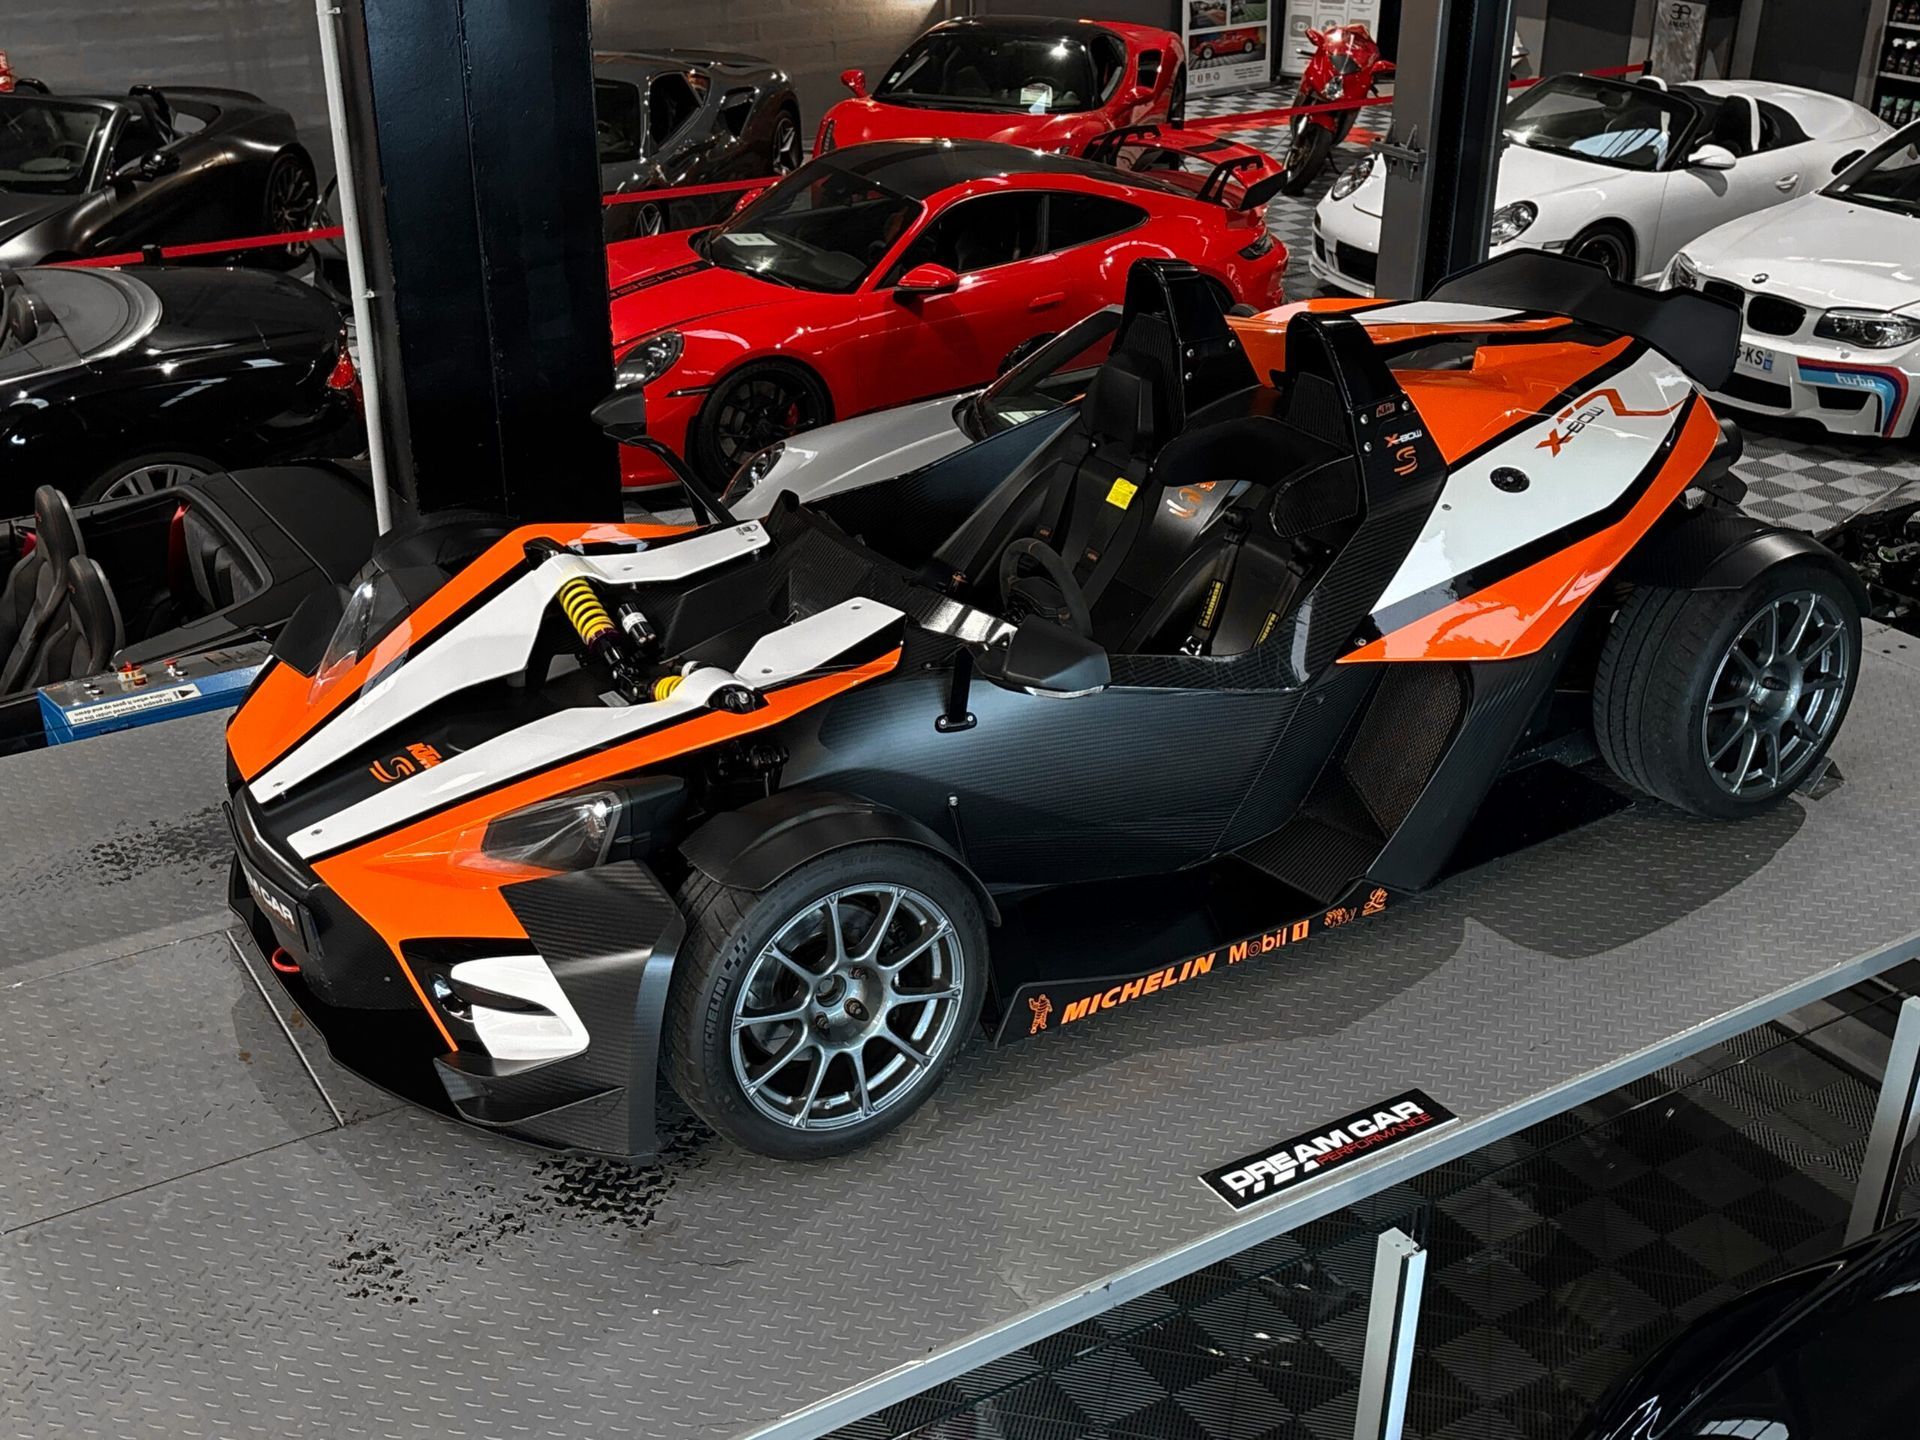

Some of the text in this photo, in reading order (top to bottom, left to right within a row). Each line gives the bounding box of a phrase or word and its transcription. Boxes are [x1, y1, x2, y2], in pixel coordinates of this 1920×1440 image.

[1835, 372, 1876, 388] turbo
[1384, 429, 1422, 448] X-BOW
[1535, 406, 1605, 458] X-BOW
[260, 886, 295, 926] CAR
[1228, 927, 1288, 965] Mobil
[1060, 953, 1217, 1025] MICHELIN
[1220, 1100, 1425, 1192] DREAM CAR
[1318, 1112, 1435, 1167] PERFORMANCE
